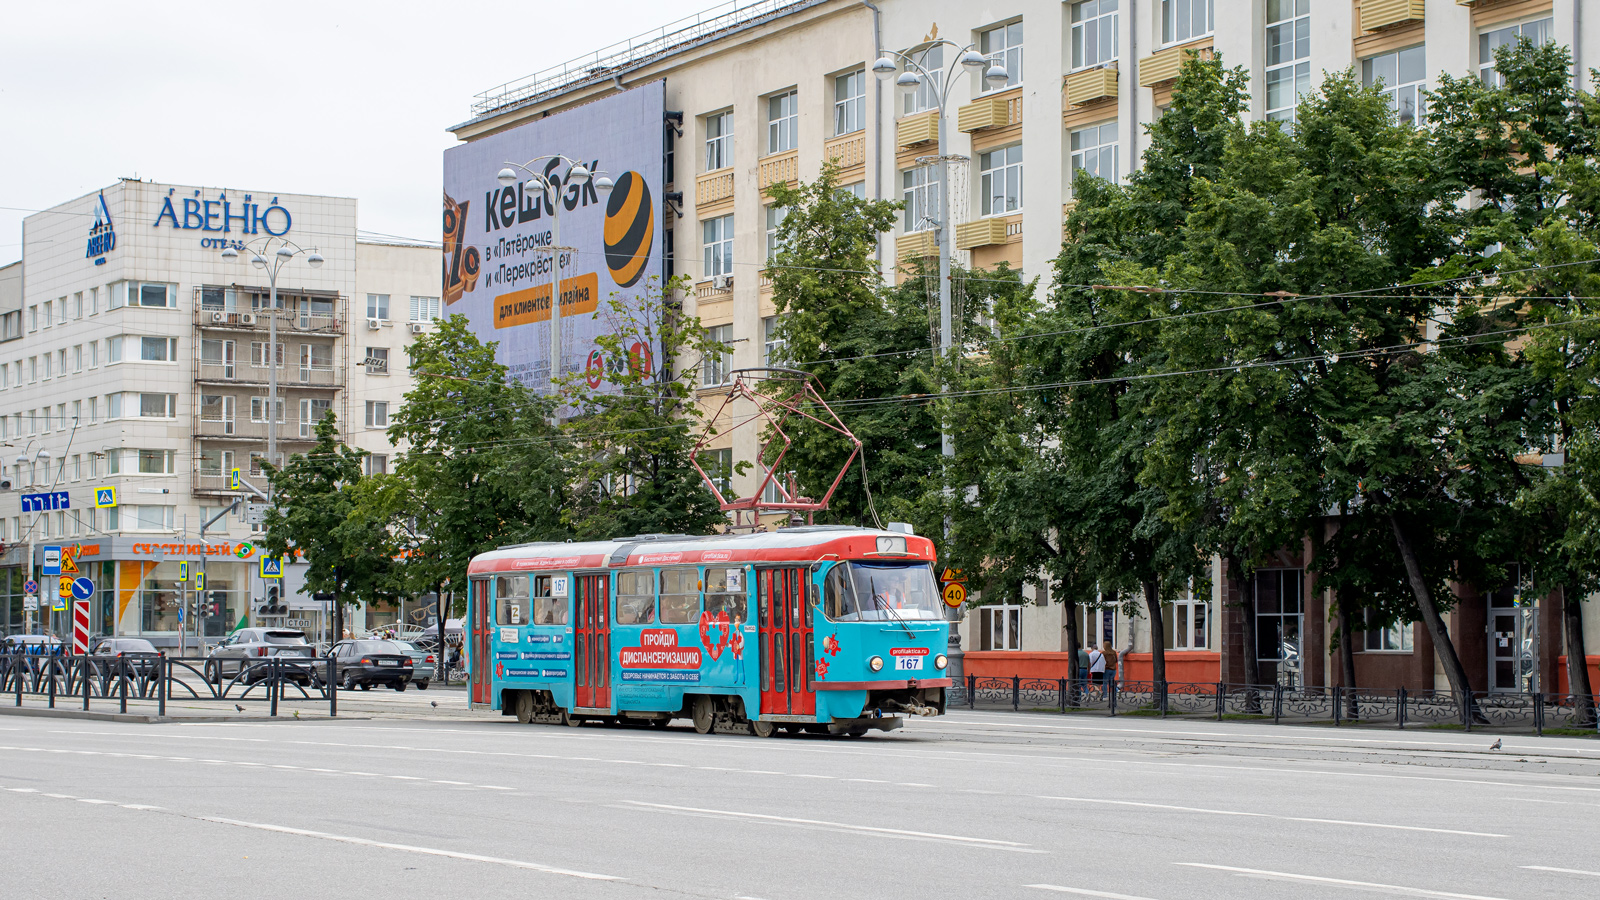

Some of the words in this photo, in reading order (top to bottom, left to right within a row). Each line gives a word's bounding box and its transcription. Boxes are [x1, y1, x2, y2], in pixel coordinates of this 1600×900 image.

[169, 188, 278, 205] ГРАНД
[486, 154, 599, 233] кешбэк
[153, 196, 292, 236] АВЕНЮ
[201, 237, 246, 251] ОТЕЛЬ
[486, 247, 491, 261] в
[486, 272, 492, 288] и
[494, 253, 571, 287] «Перекрёсте»
[499, 304, 512, 321] для
[514, 295, 550, 316] клиентов
[132, 541, 232, 556] счстлиый
[60, 582, 72, 591] 40
[554, 579, 566, 592] 167
[947, 589, 962, 601] 40
[512, 606, 519, 618] 2
[288, 618, 310, 627] СТОП
[643, 631, 675, 647] ПРОЙДИ
[622, 651, 699, 665] ДИСПАНСЕРИЗАЦИЮ
[900, 658, 919, 670] 167
[622, 672, 642, 680] ЗДОРОВЬЕ
[670, 673, 685, 681] ЗАБОТЫ
